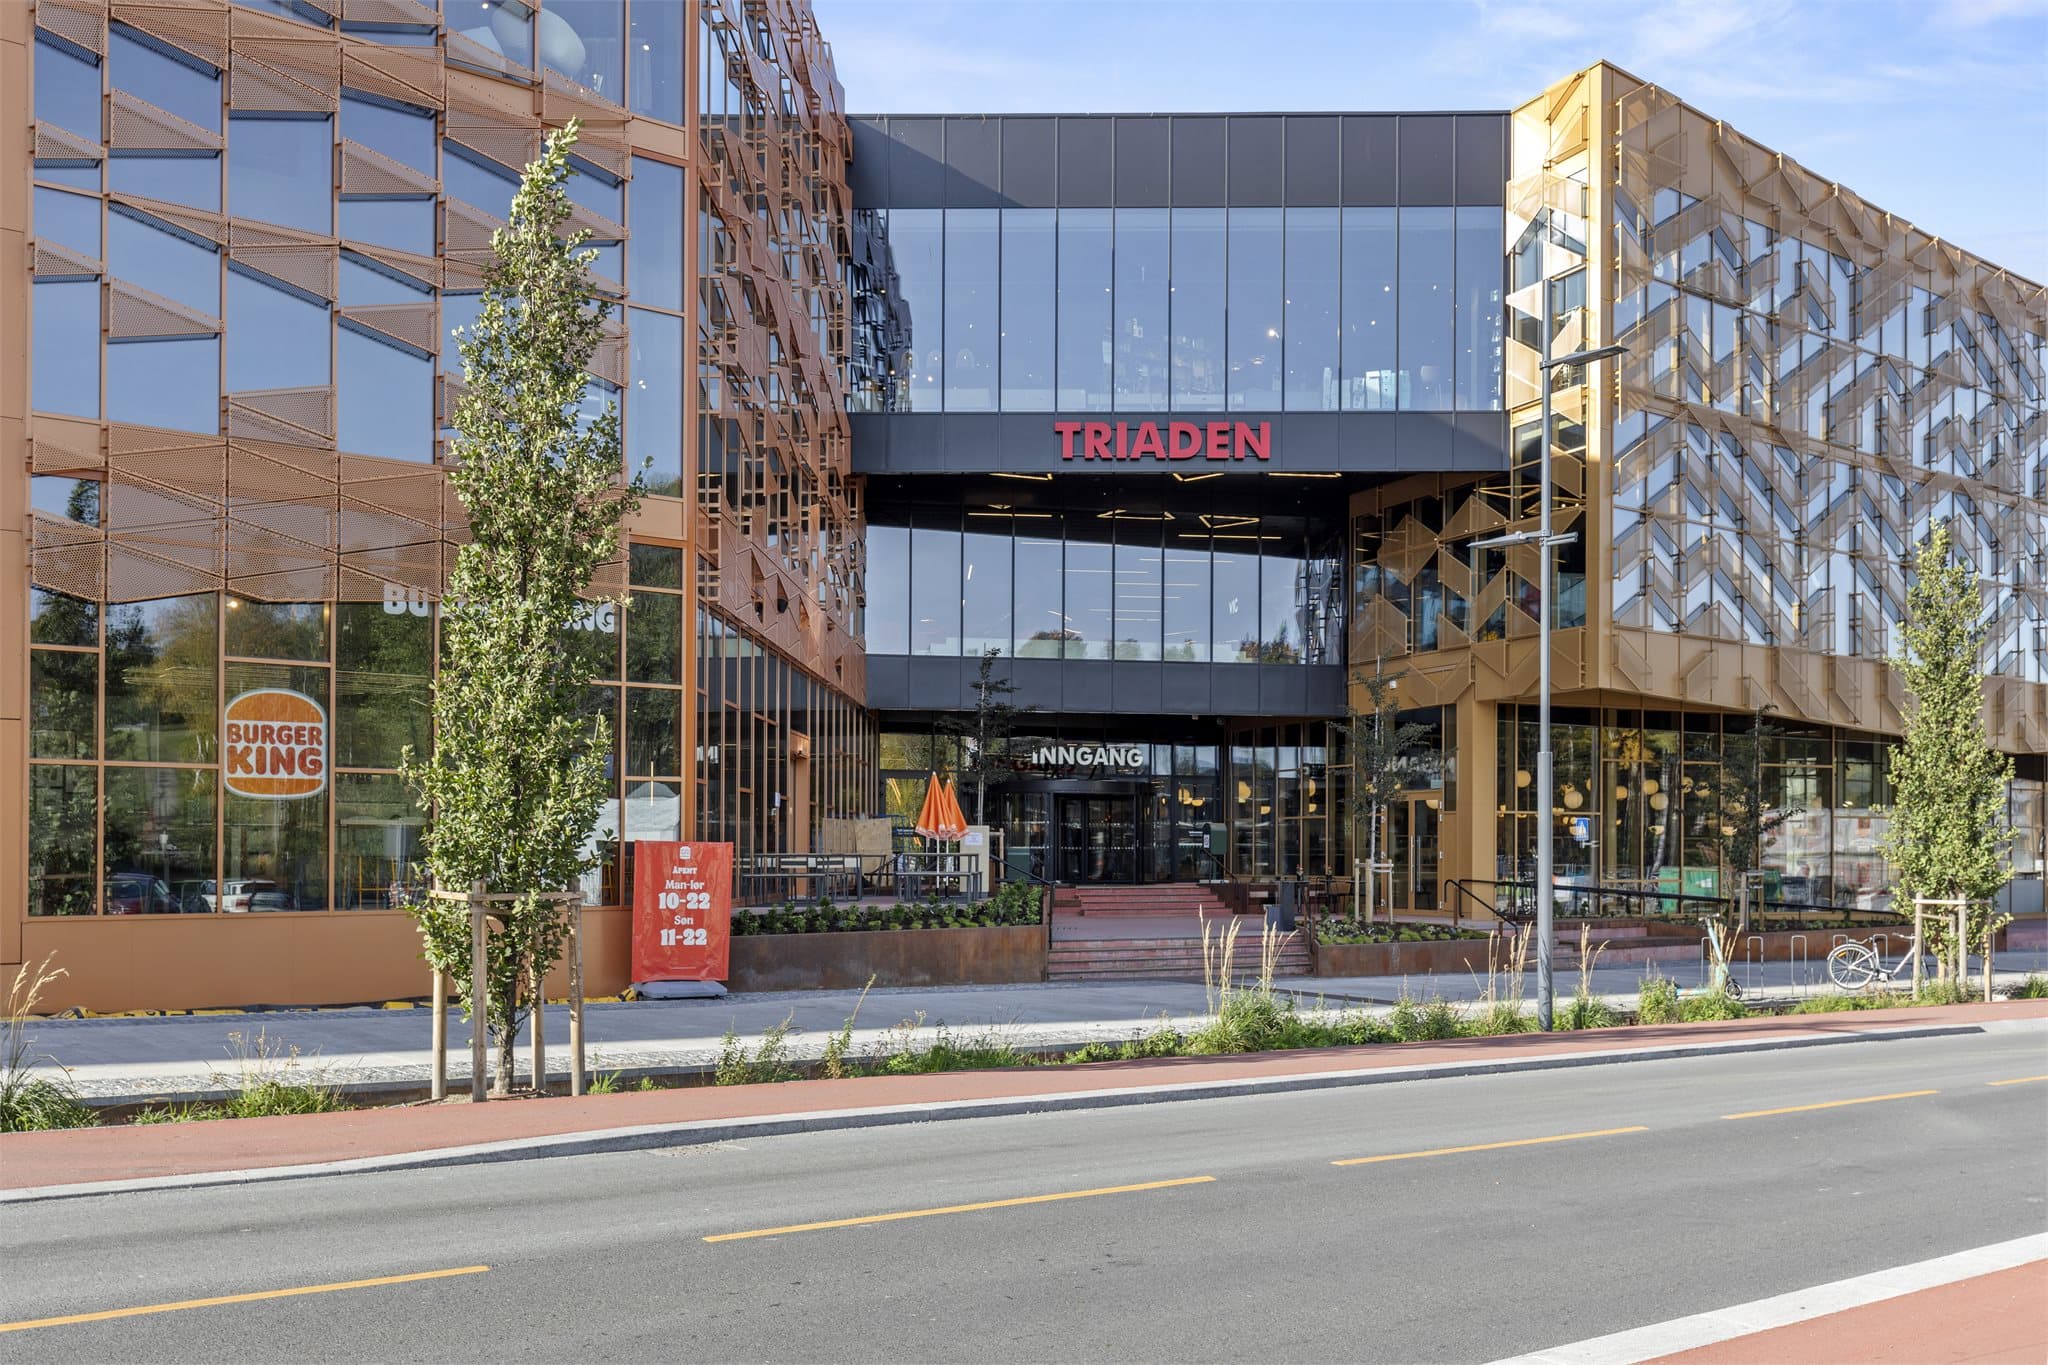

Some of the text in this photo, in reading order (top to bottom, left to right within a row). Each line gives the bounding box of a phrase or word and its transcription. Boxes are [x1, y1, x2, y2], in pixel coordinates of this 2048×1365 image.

[1055, 421, 1271, 460] TRIADEN
[226, 723, 323, 746] BURGER
[226, 745, 323, 776] KING
[1032, 746, 1144, 767] INNGANG
[658, 892, 710, 909] 10-22
[660, 928, 707, 946] 11-22
